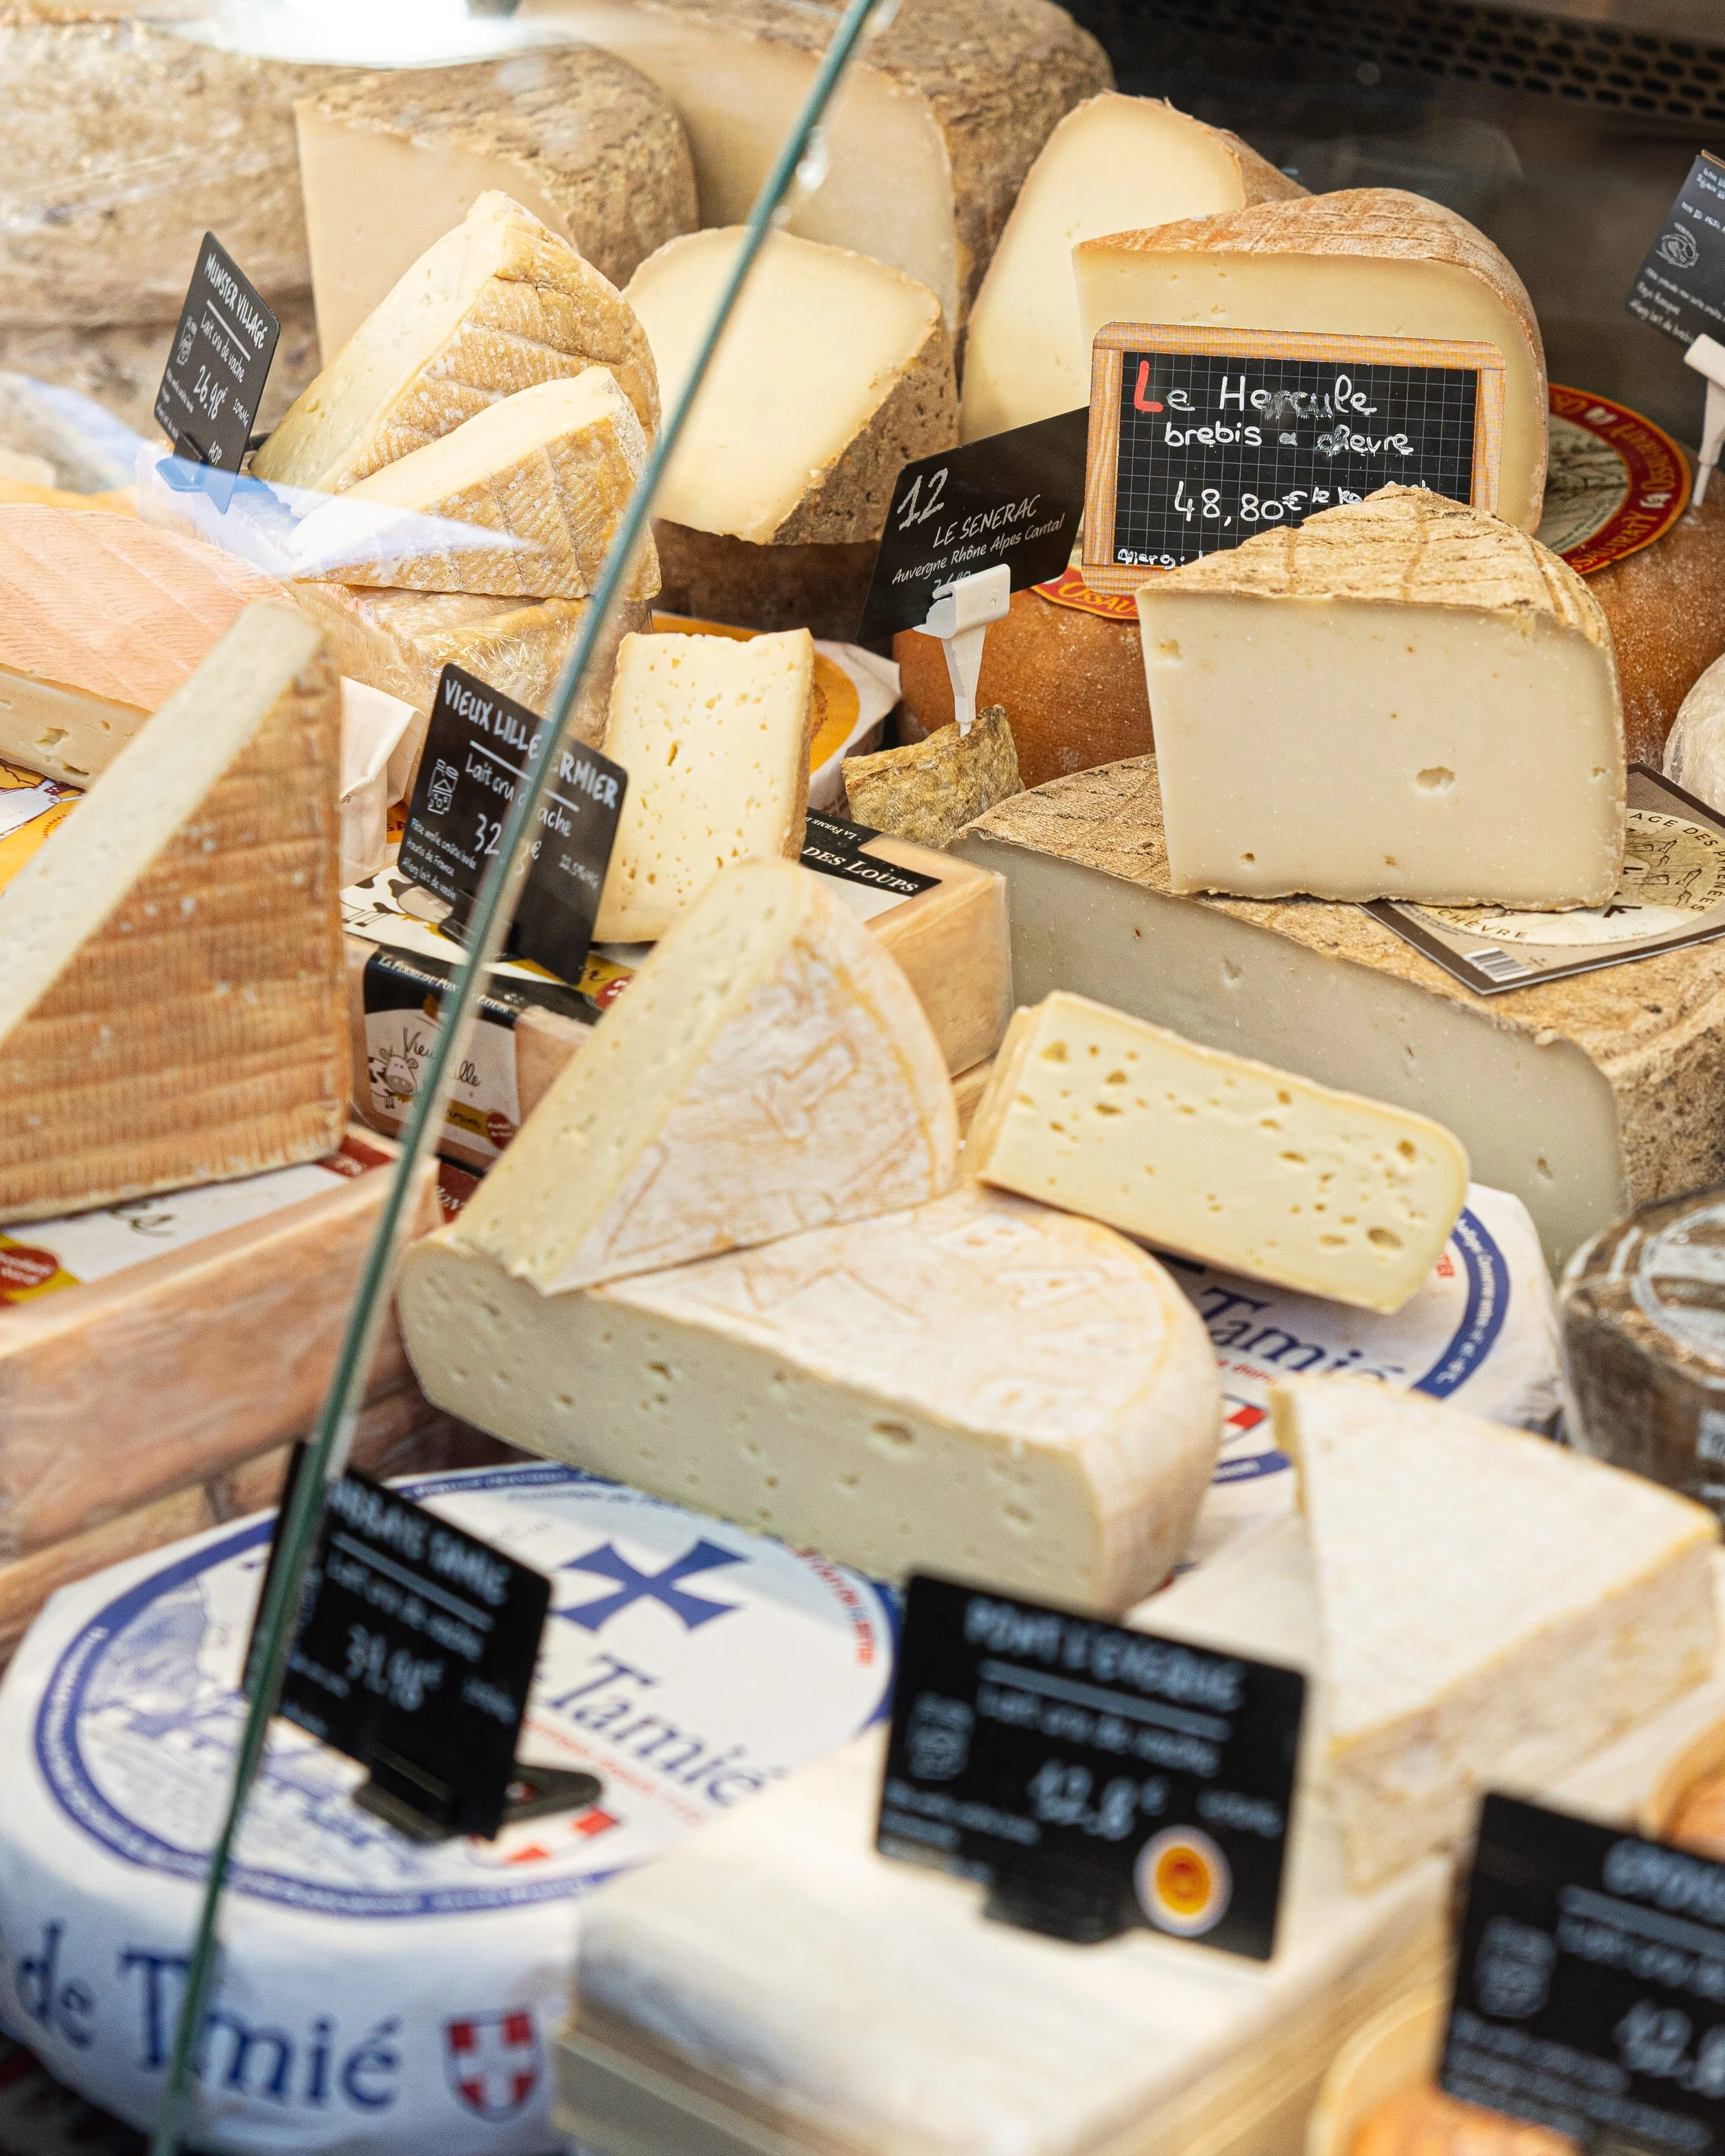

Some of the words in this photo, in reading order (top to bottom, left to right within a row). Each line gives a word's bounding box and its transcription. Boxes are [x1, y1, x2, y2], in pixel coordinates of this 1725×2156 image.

[204, 253, 239, 311] MUNSTER
[236, 293, 268, 349] VILLAGE
[201, 311, 215, 339] Lait
[228, 353, 245, 384] vache
[1134, 359, 1196, 413] Le
[208, 440, 222, 466] AOP
[1163, 420, 1262, 448] brebis
[896, 467, 949, 531] 12
[933, 522, 958, 548] LE
[959, 494, 1041, 540] SENERAC
[892, 556, 947, 585] Auvergne
[951, 545, 987, 564] Rhône
[989, 532, 1021, 556] Alpes
[1025, 513, 1065, 541] Cantal
[444, 678, 493, 731] VIEUX
[493, 709, 543, 759] LILLE
[559, 751, 620, 809] RMIER
[464, 753, 493, 783] Lait
[492, 776, 515, 801] cru
[537, 806, 572, 837] ache
[1628, 812, 1679, 827] AGE
[1682, 827, 1719, 847] DES
[801, 846, 847, 866] DES
[844, 860, 920, 892] LOUPS
[402, 1026, 433, 1061] Vieu
[458, 1059, 481, 1087] lle
[17, 1925, 94, 2048] de
[118, 1948, 401, 2110] Tmié
